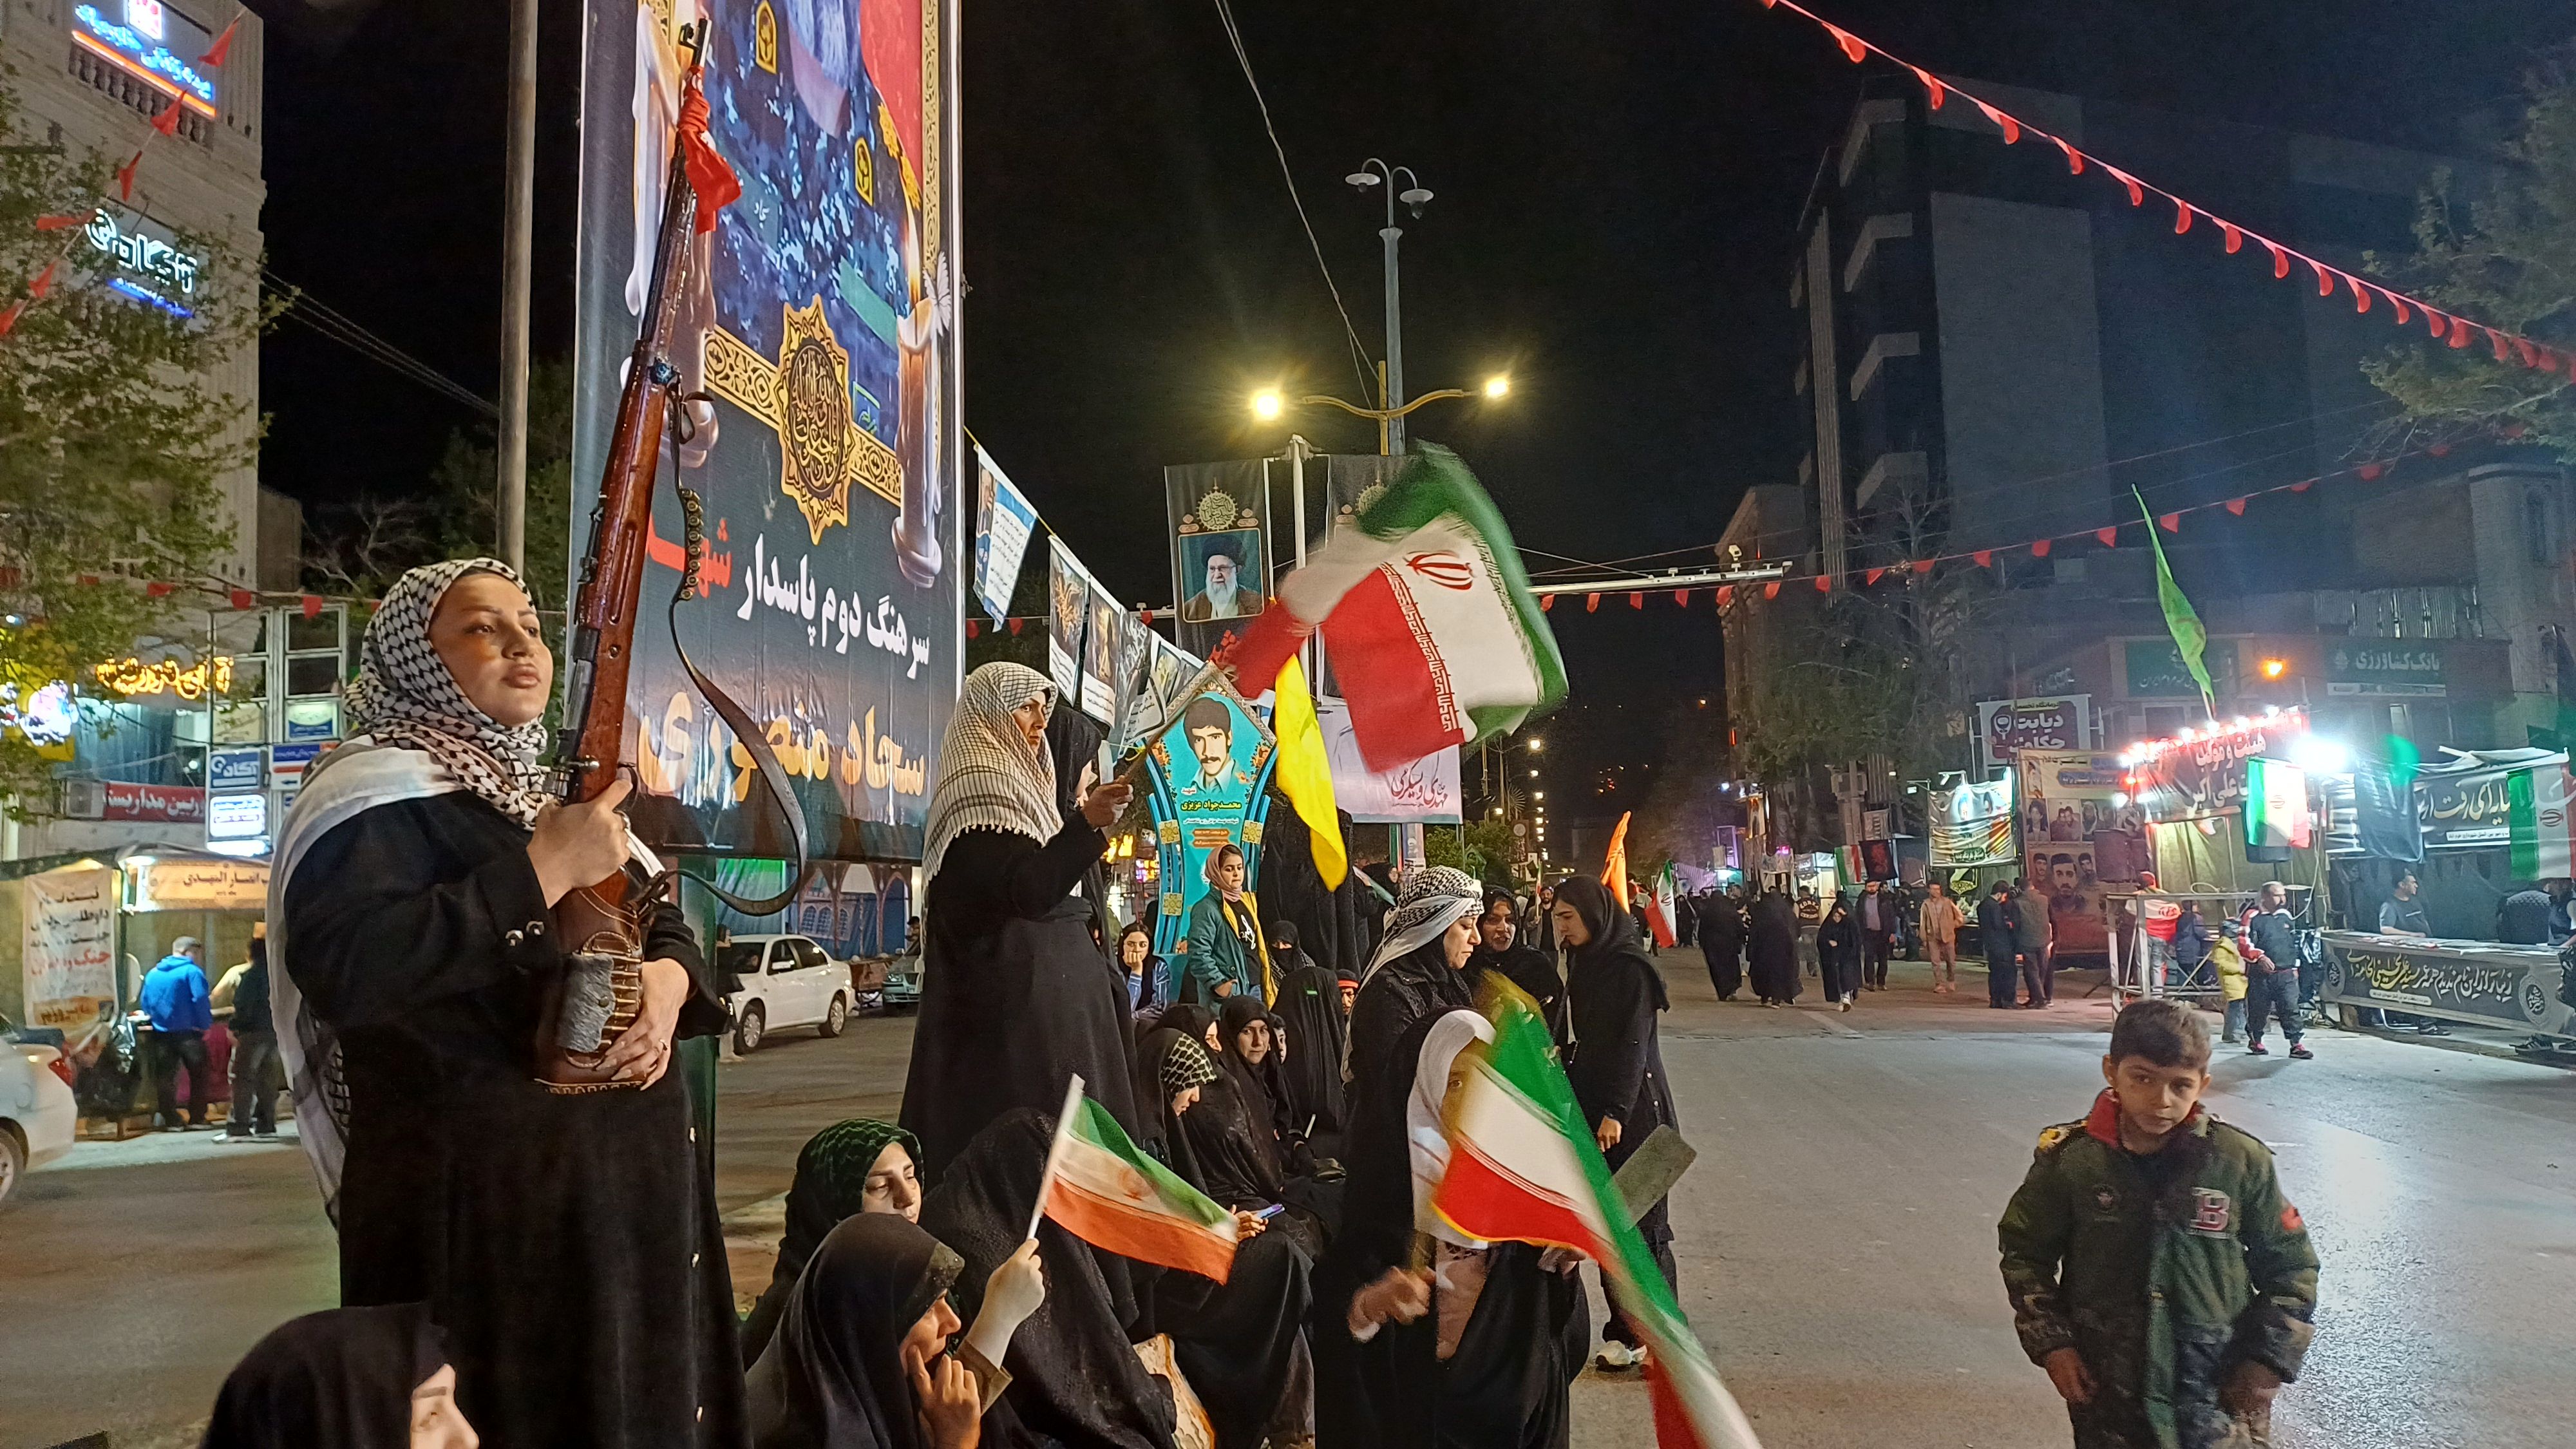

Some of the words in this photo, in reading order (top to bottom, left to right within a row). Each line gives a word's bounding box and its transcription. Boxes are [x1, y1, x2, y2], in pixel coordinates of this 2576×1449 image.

[646, 513, 732, 599] شهد
[737, 533, 817, 645] پاسدار
[821, 587, 862, 654] دوم
[2356, 650, 2410, 670] کشاورزی
[2014, 713, 2063, 734] دیابت
[841, 706, 924, 796] سجاد
[2226, 745, 2233, 768] و
[1181, 800, 1202, 811] عزیزی
[2488, 782, 2510, 826] ایه
